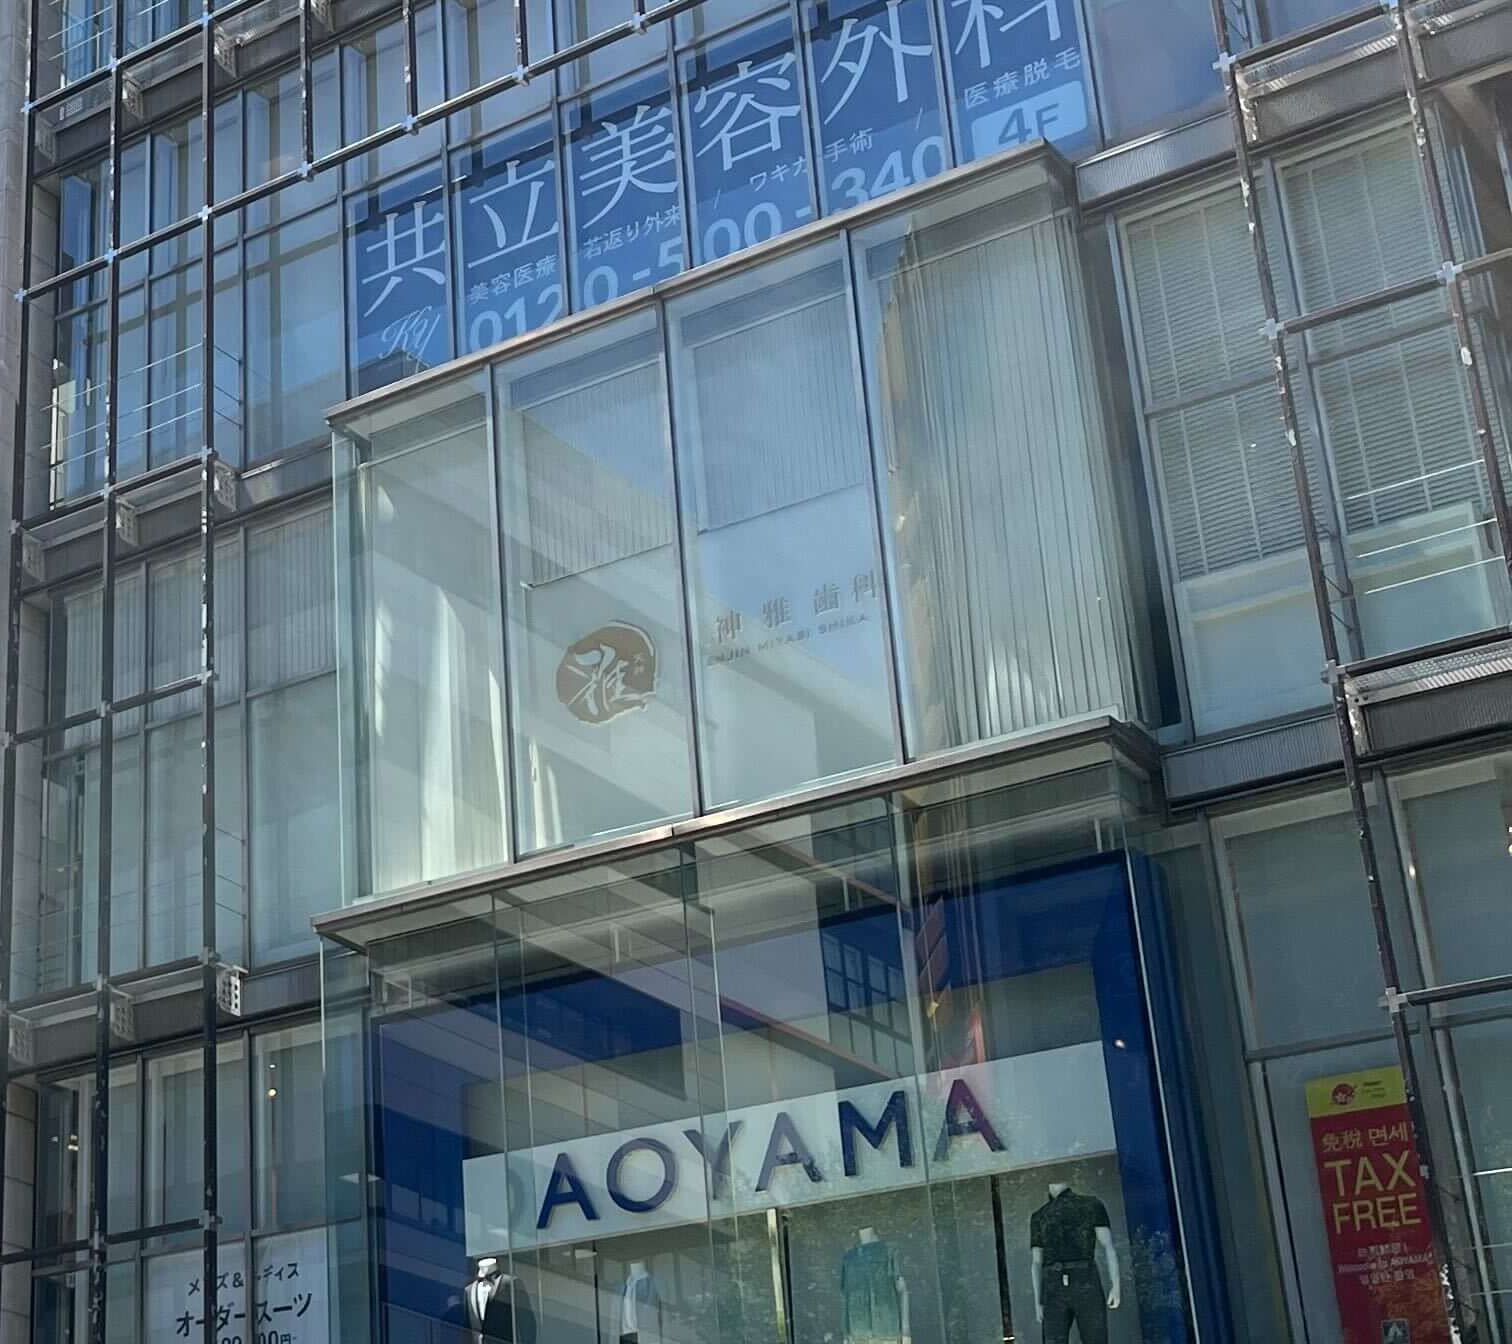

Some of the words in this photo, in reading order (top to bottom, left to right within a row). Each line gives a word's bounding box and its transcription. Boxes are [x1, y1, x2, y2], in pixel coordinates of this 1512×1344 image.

[963, 47, 1081, 109] 医療脱毛
[998, 102, 1060, 144] 4F
[582, 205, 682, 259] 若返り外来
[468, 253, 558, 305] 美容医療
[536, 1078, 1007, 1230] AOYAMA
[1369, 1120, 1409, 1146] 면세
[1323, 1150, 1417, 1196] TAX
[1333, 1193, 1422, 1234] FREE
[175, 1292, 313, 1337] オーダースーツ
